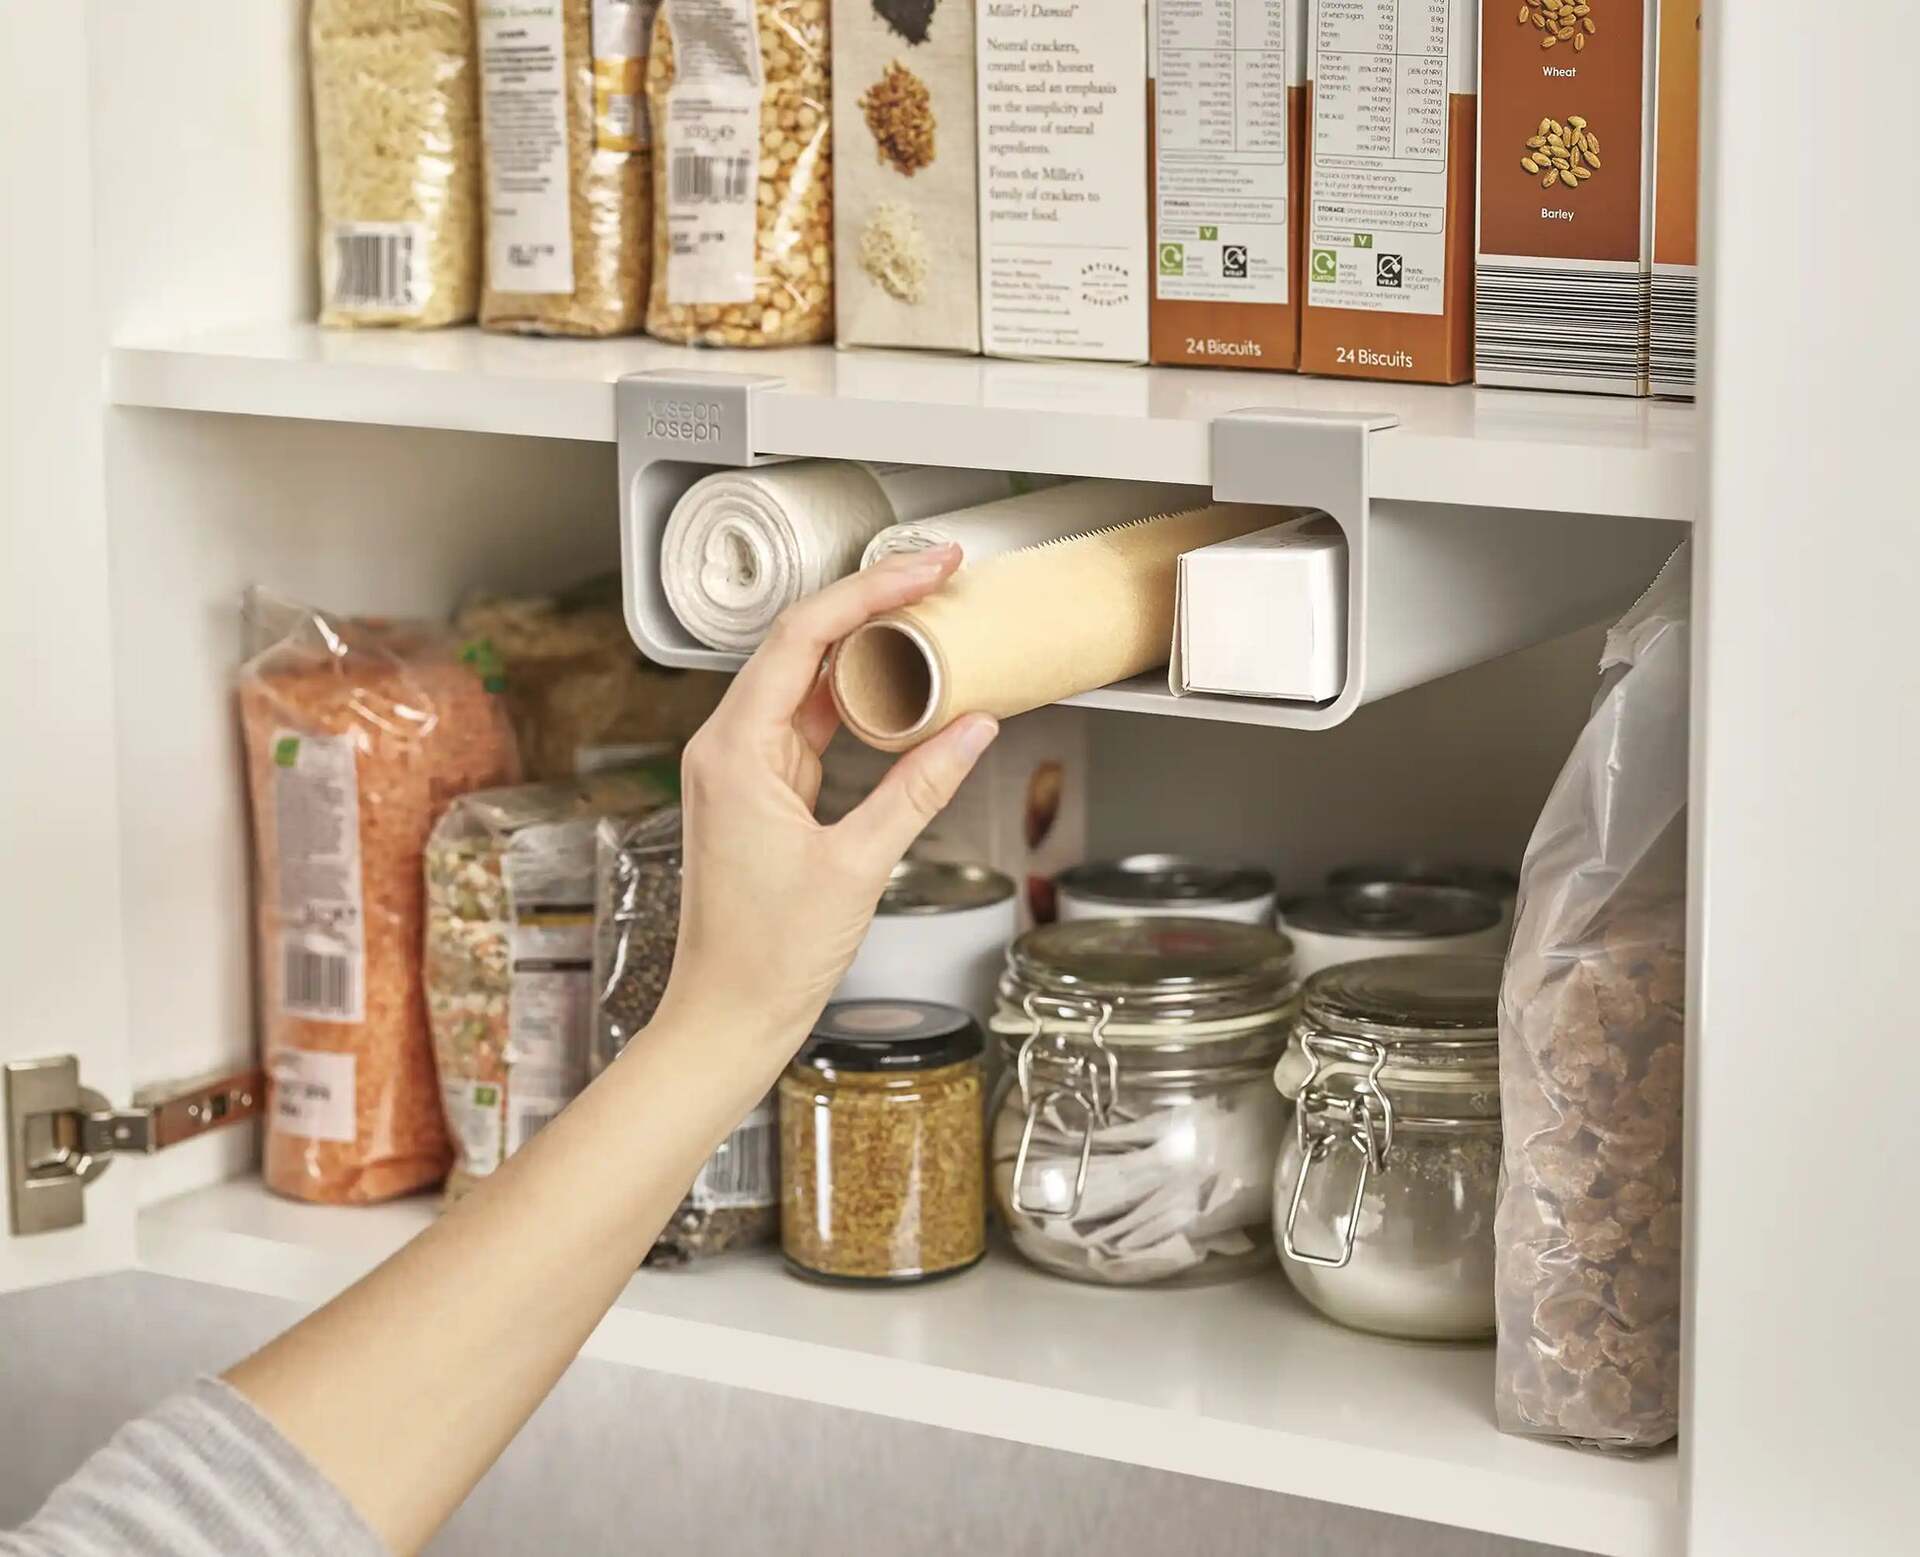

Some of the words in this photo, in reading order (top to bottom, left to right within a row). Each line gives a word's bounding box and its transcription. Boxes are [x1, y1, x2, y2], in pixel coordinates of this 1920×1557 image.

[987, 38, 1028, 51] Neutral
[1542, 65, 1577, 77] Wheat
[1026, 82, 1046, 93] and
[1005, 102, 1022, 113] the
[1083, 102, 1103, 115] and
[1041, 121, 1053, 133] of
[989, 167, 1018, 179] From
[1021, 167, 1039, 179] the
[1026, 188, 1038, 200] of
[1088, 190, 1100, 202] to
[1541, 208, 1575, 222] Barley
[1185, 337, 1205, 355] 24
[1207, 338, 1262, 357] Biscuits
[1335, 347, 1355, 363] 24
[1358, 349, 1413, 368] Biscuits
[647, 416, 721, 443] Joseph
